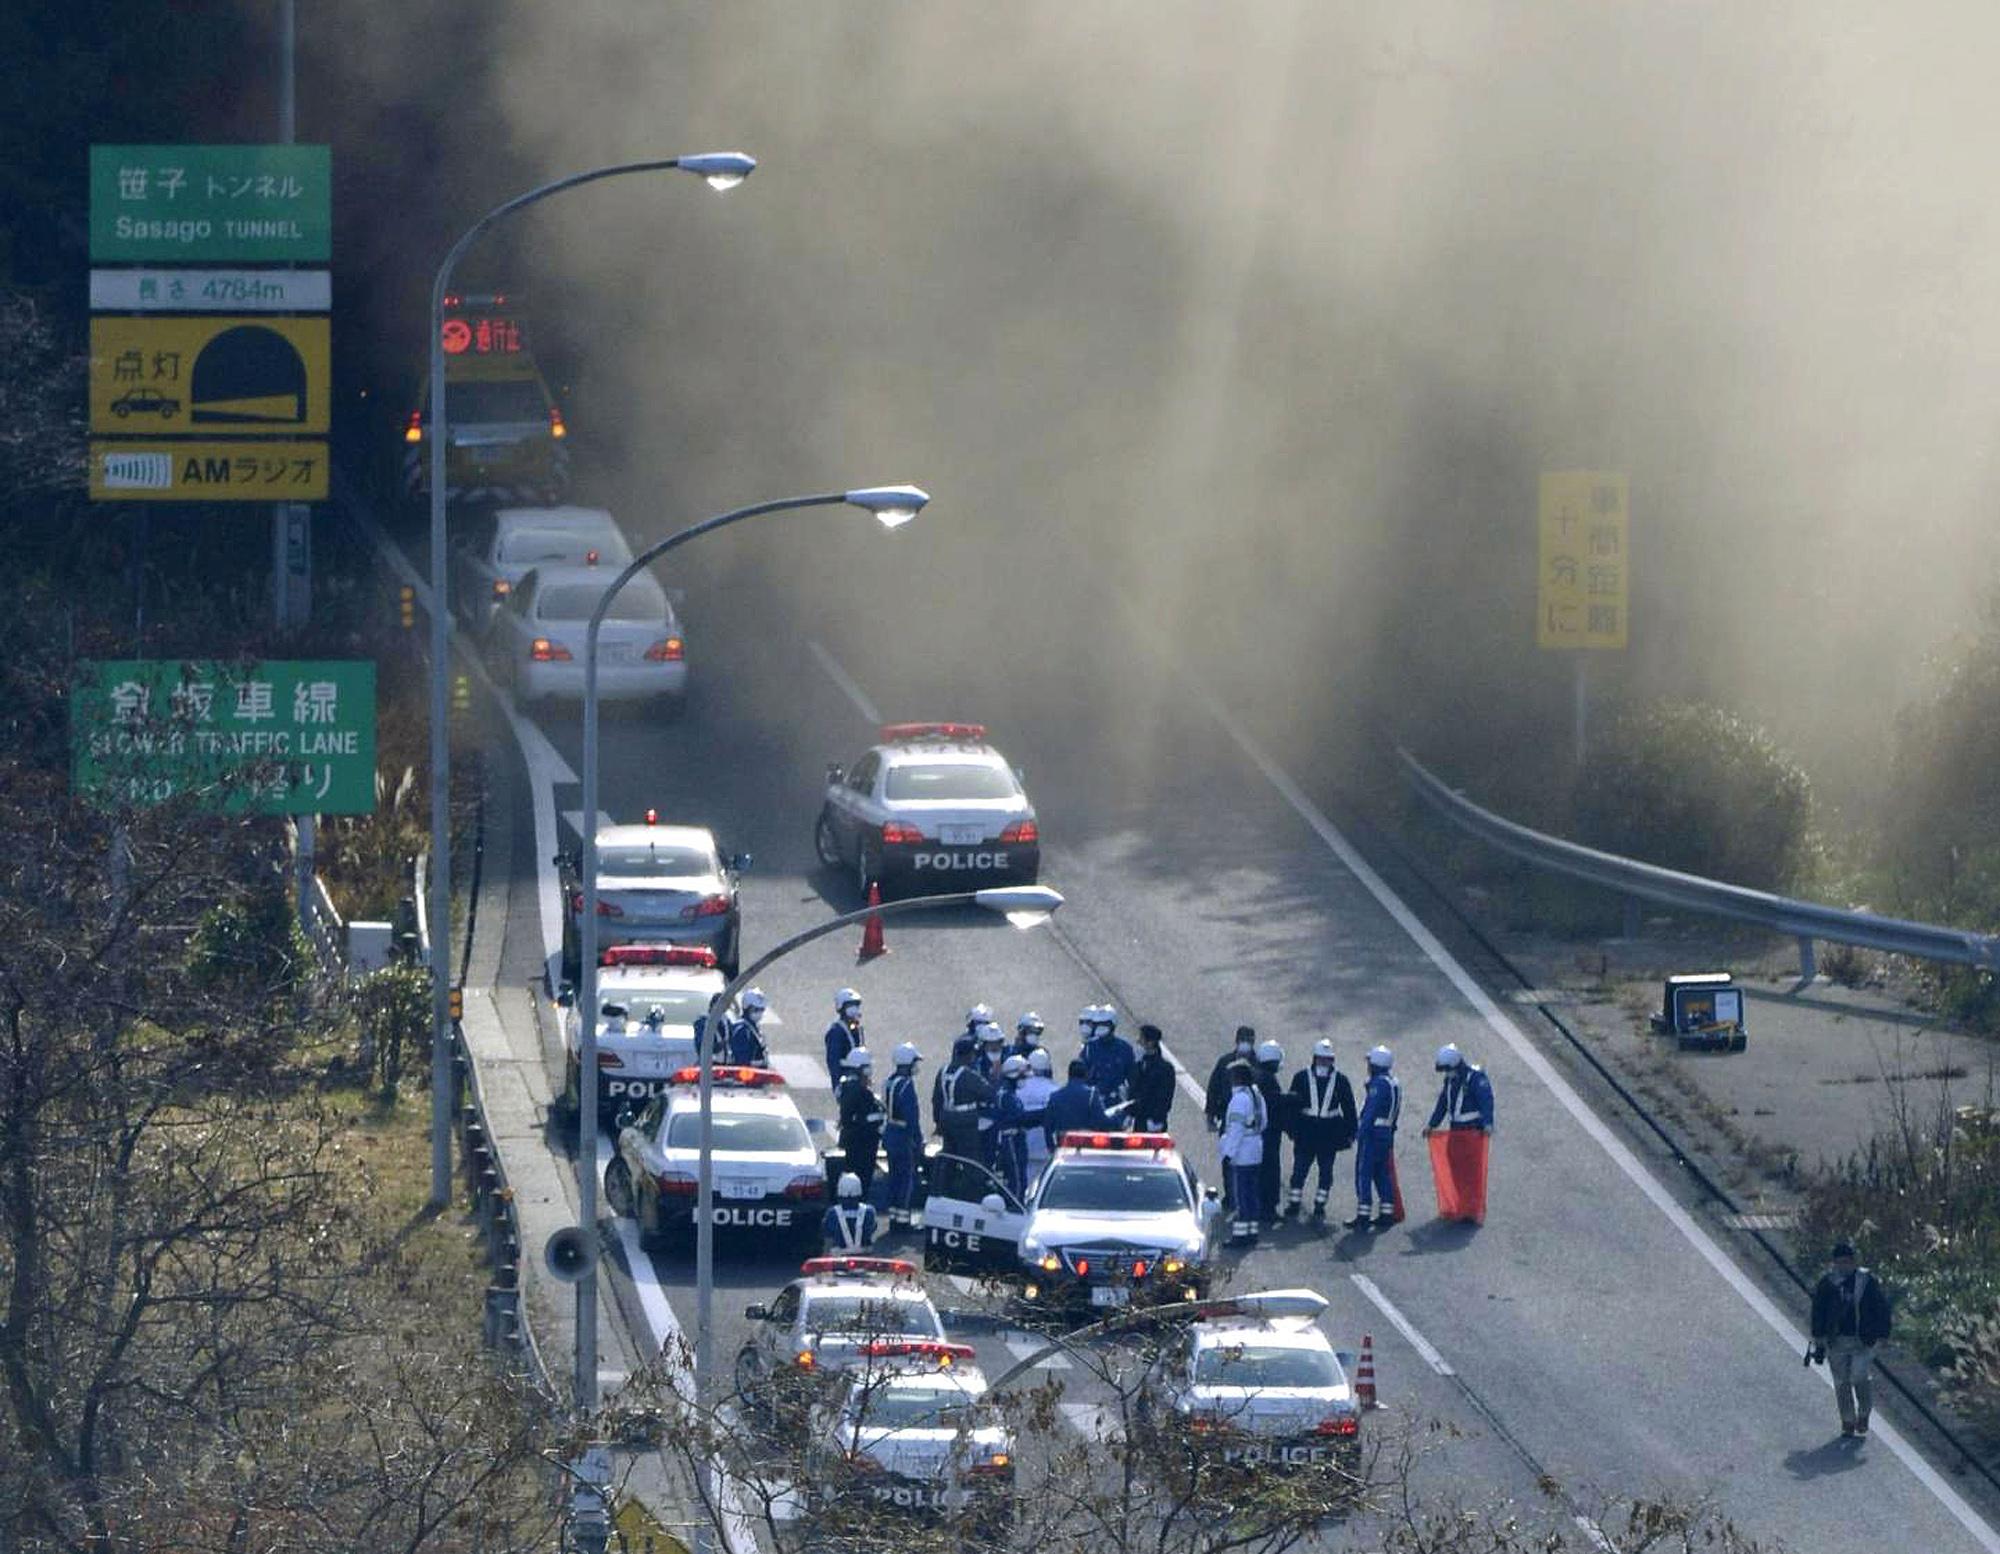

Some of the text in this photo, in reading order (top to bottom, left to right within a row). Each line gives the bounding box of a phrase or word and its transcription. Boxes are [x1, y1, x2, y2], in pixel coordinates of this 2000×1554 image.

[206, 175, 304, 199] トンネル
[115, 215, 303, 243] Sasago TUNNEL
[201, 279, 285, 300] 4784m
[113, 350, 182, 381] 点灯
[181, 456, 318, 485] AMラジオ
[194, 731, 290, 755] TRAFFIC
[300, 731, 359, 755] LANE
[913, 852, 1010, 871] POLICE
[931, 1228, 981, 1253] ICE
